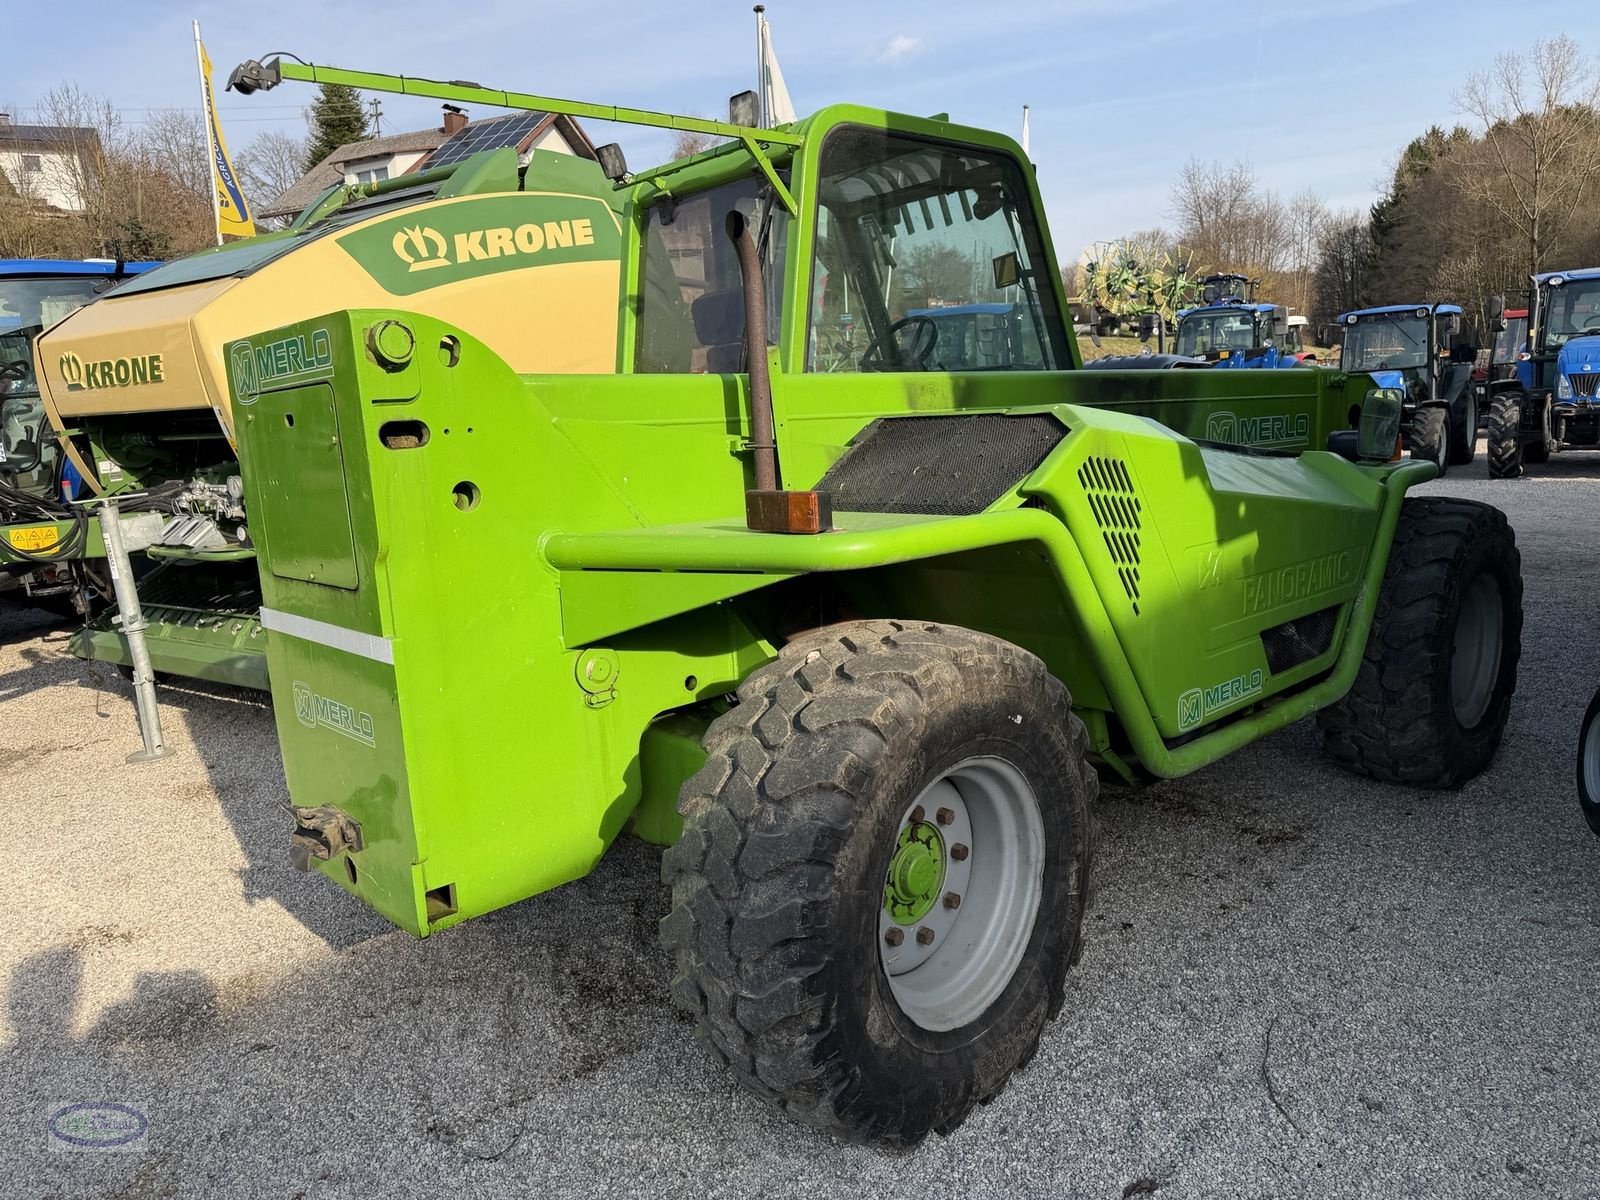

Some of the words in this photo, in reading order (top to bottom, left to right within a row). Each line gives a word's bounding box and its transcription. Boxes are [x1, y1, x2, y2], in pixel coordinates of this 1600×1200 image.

[454, 218, 595, 264] KRONE
[85, 354, 164, 389] KRONE
[256, 328, 332, 380] MERLO
[1239, 413, 1310, 444] MERLO
[1243, 551, 1350, 615] PANORAMIC
[1204, 668, 1263, 710] MERLO
[314, 694, 375, 740] MERLO
